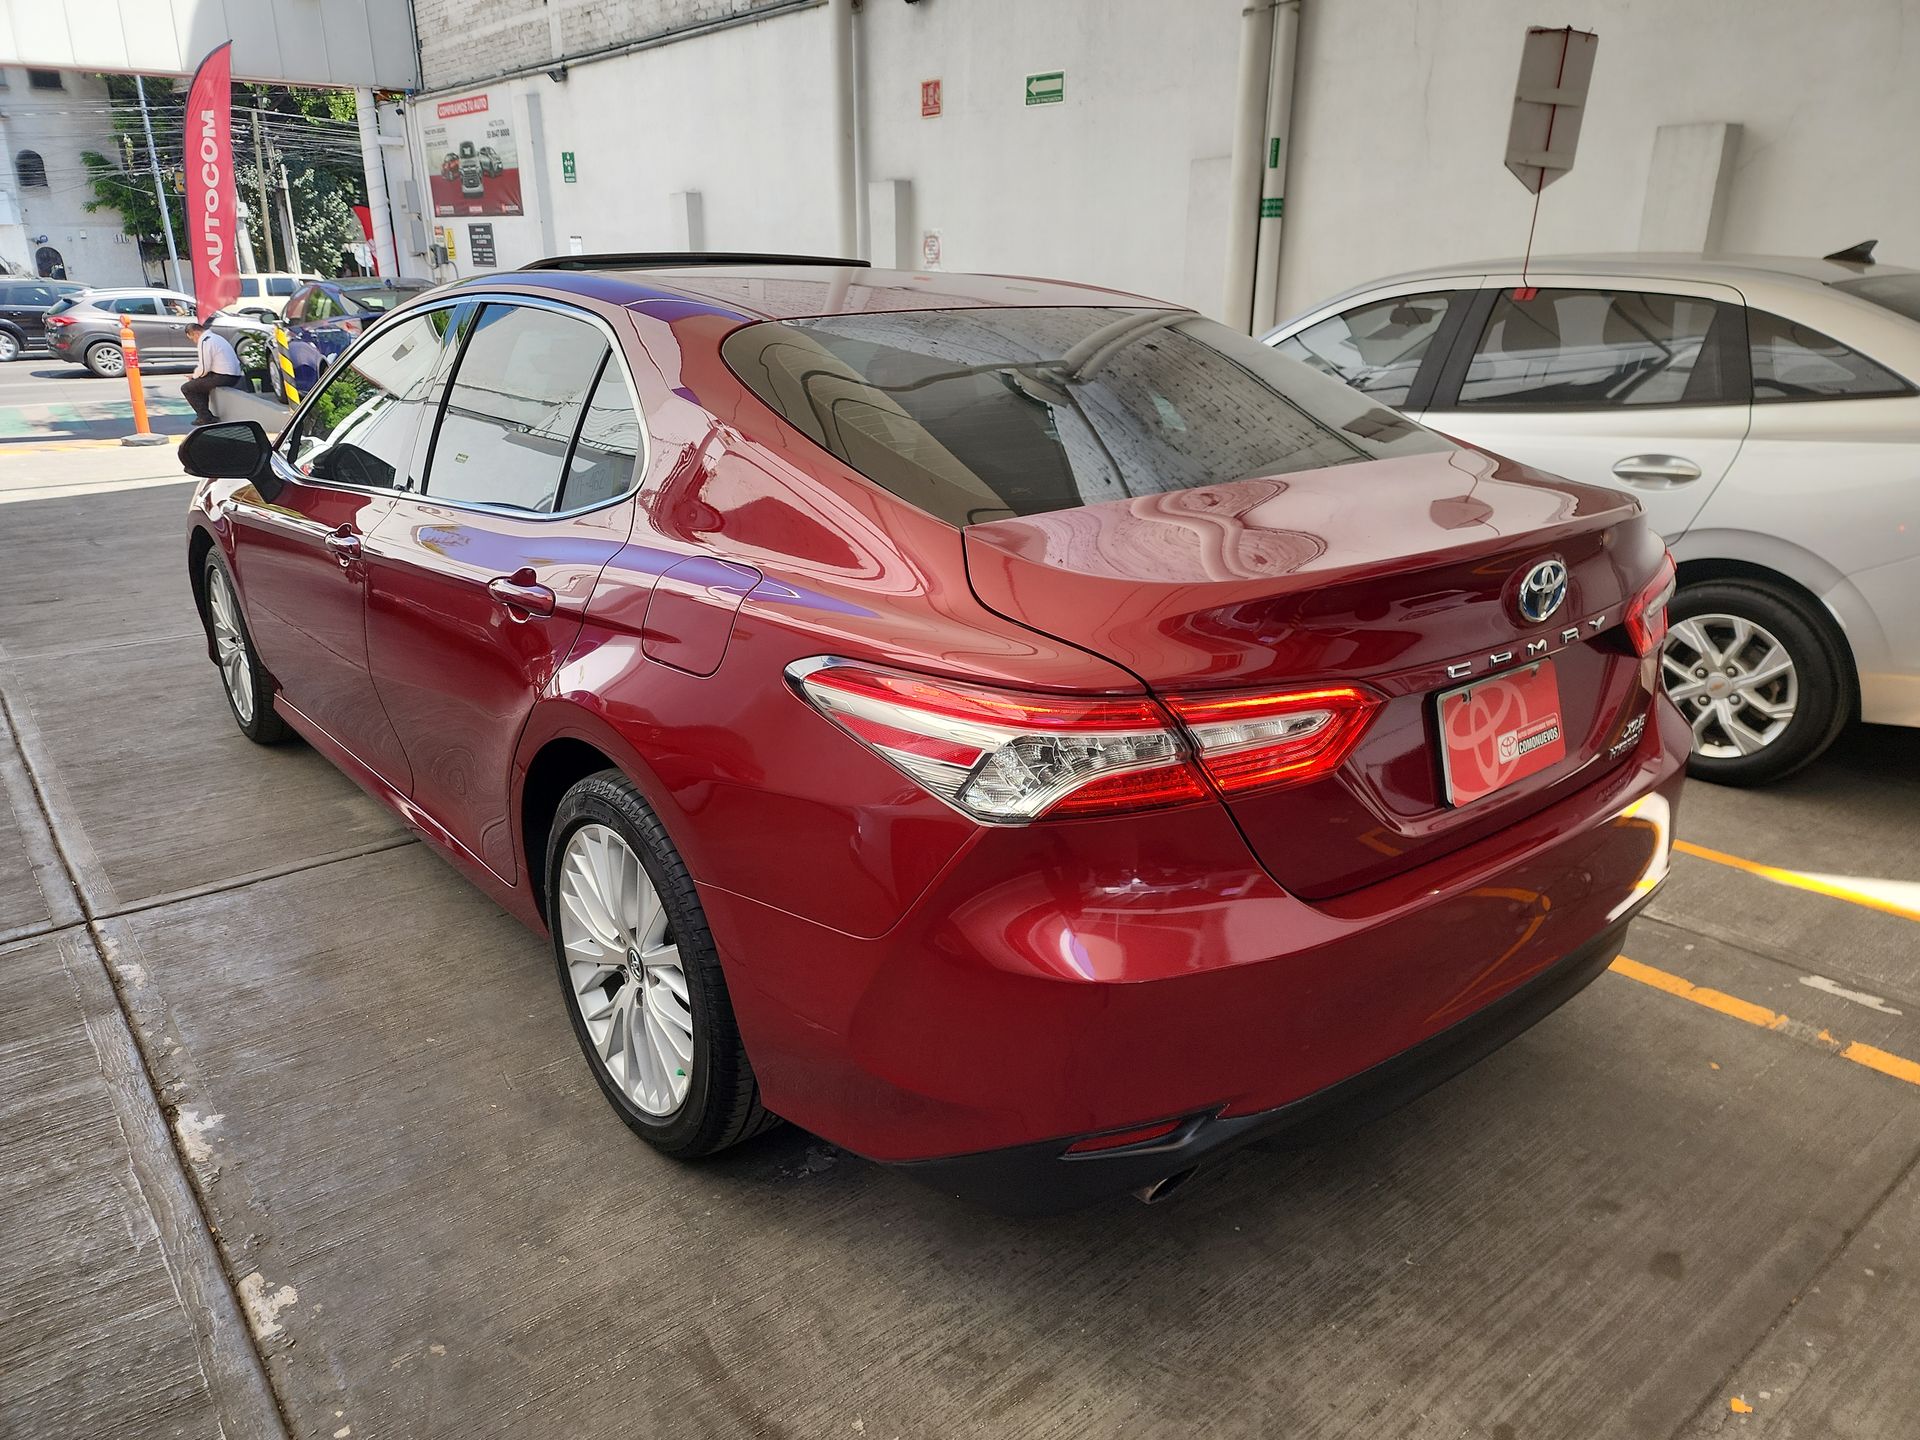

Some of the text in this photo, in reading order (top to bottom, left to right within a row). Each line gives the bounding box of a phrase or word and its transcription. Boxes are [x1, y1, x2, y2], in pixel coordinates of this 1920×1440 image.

[200, 109, 223, 278] AUTOCOM
[1447, 615, 1606, 678] CAMRY
[1518, 727, 1559, 755] COMONUEVOS
